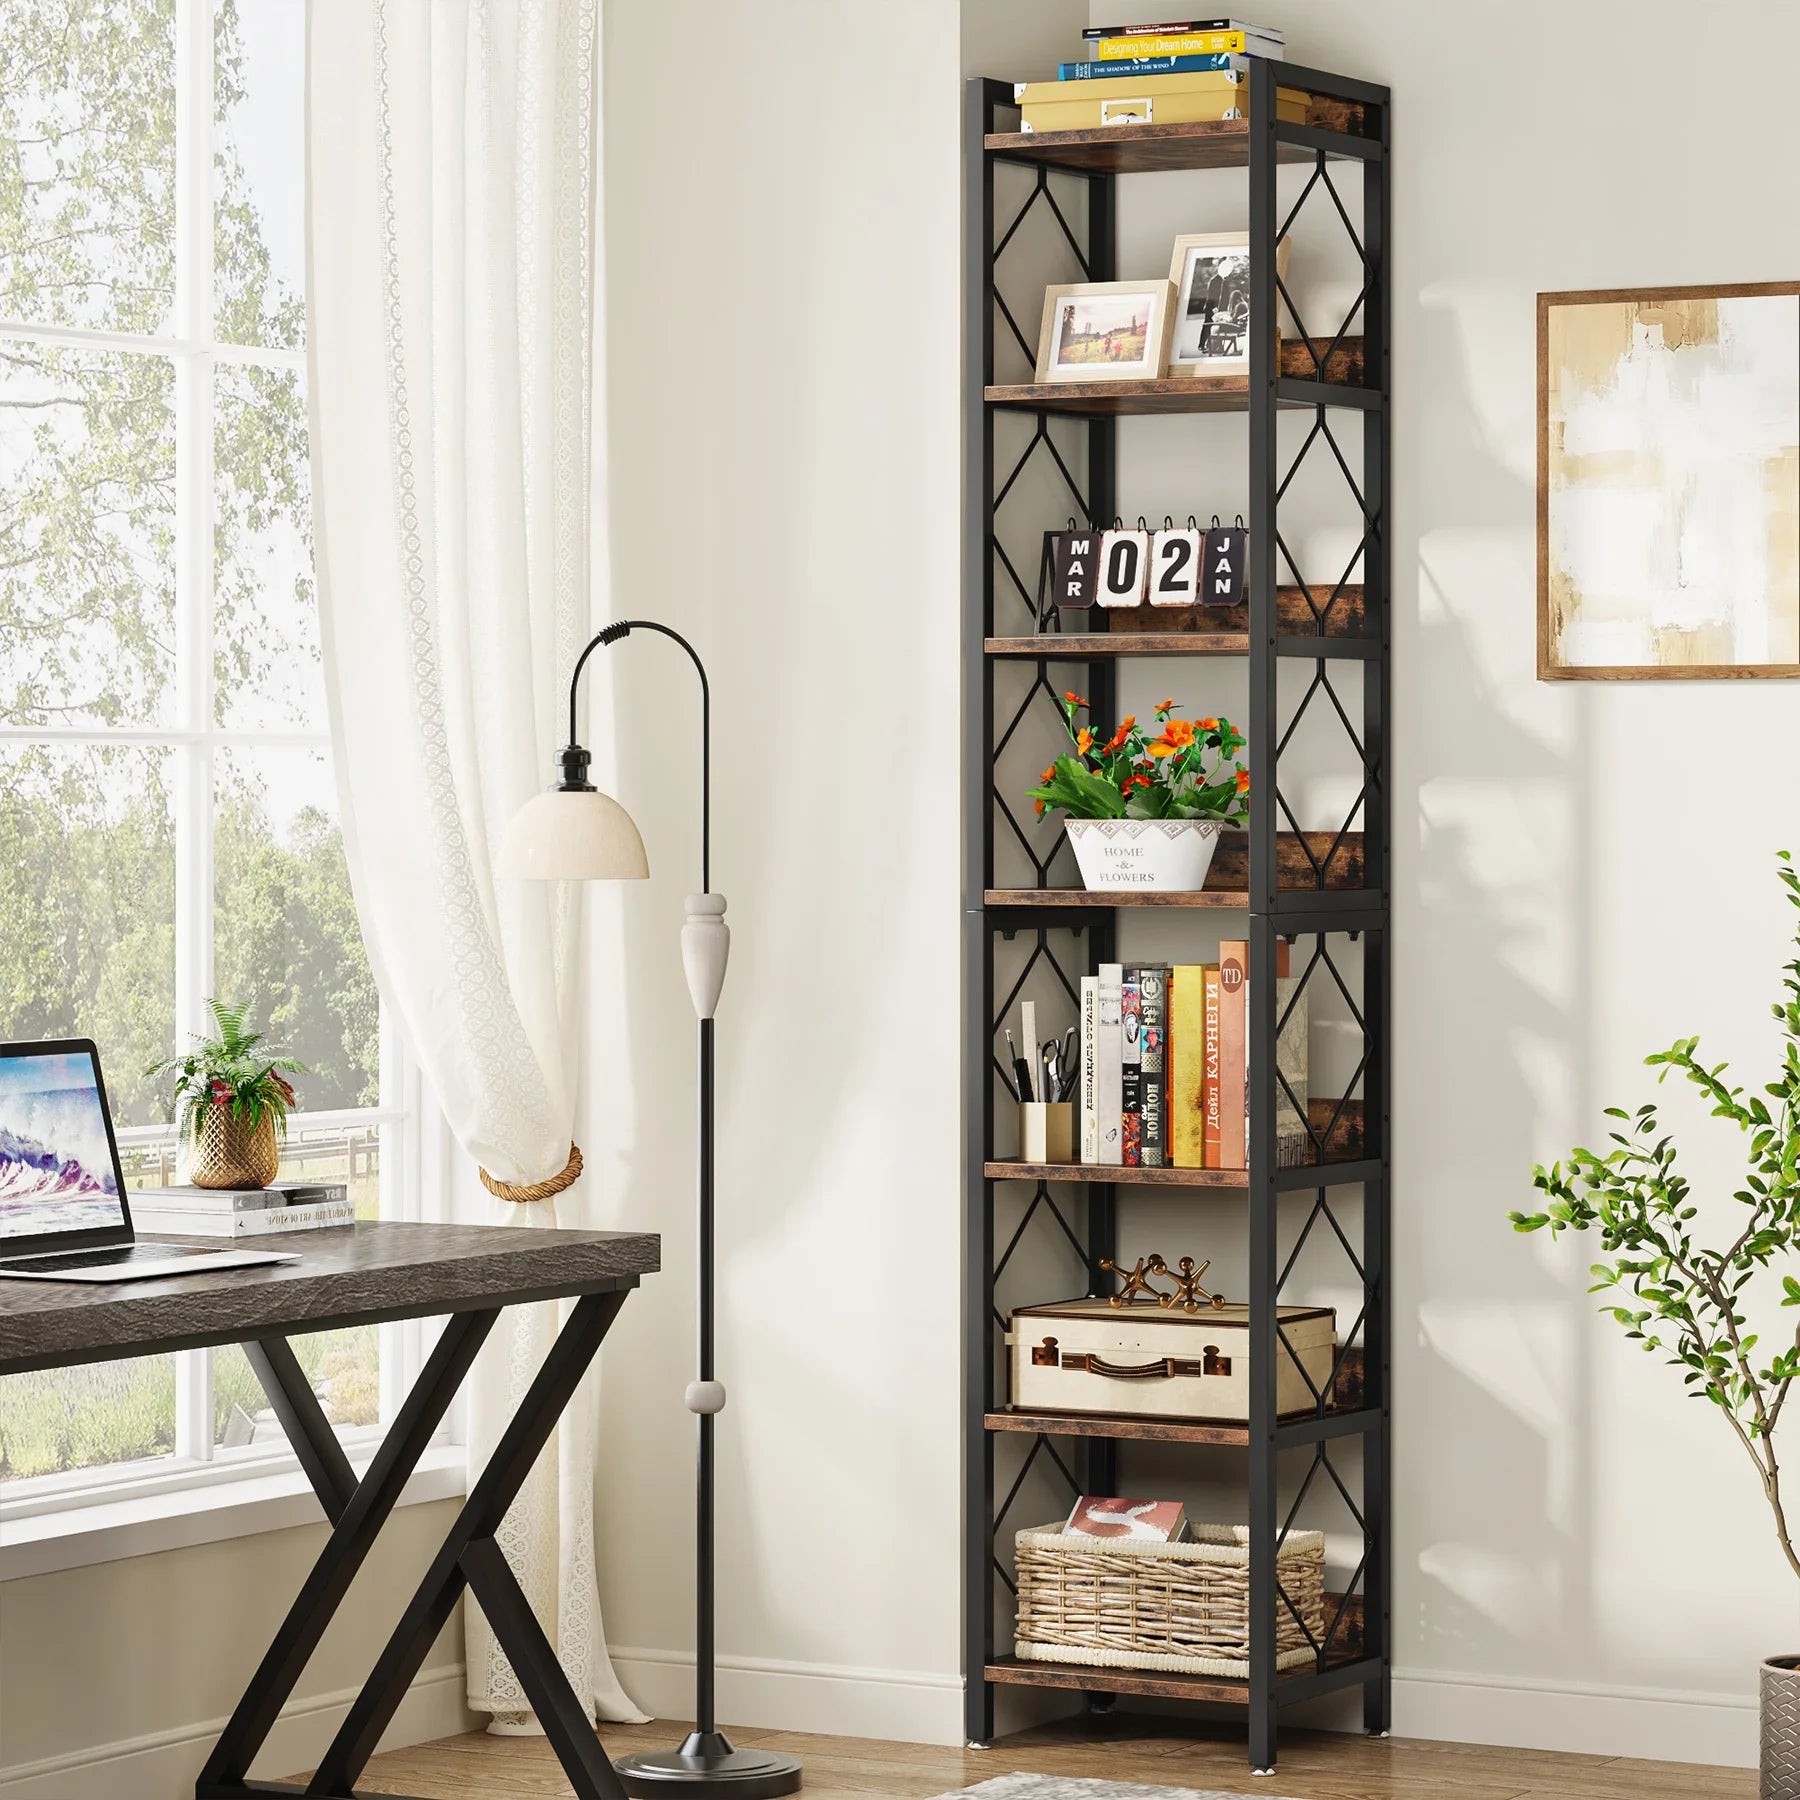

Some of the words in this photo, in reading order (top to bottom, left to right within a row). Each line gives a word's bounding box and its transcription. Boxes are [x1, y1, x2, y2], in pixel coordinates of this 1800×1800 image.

[1103, 41, 1138, 56] Designing
[1139, 40, 1155, 52] Your
[1156, 39, 1180, 51] Dream
[1182, 38, 1203, 50] Home
[1106, 65, 1131, 73] SHADOW
[1152, 62, 1170, 70] WIND
[1104, 847, 1144, 857] HOME
[1100, 872, 1155, 883] FLOWERS
[1223, 968, 1242, 984] TD
[1206, 982, 1219, 1079] КАРНЕГИ
[1147, 1083, 1161, 1140] ЛОНДОН
[1207, 1086, 1220, 1129] Дейл
